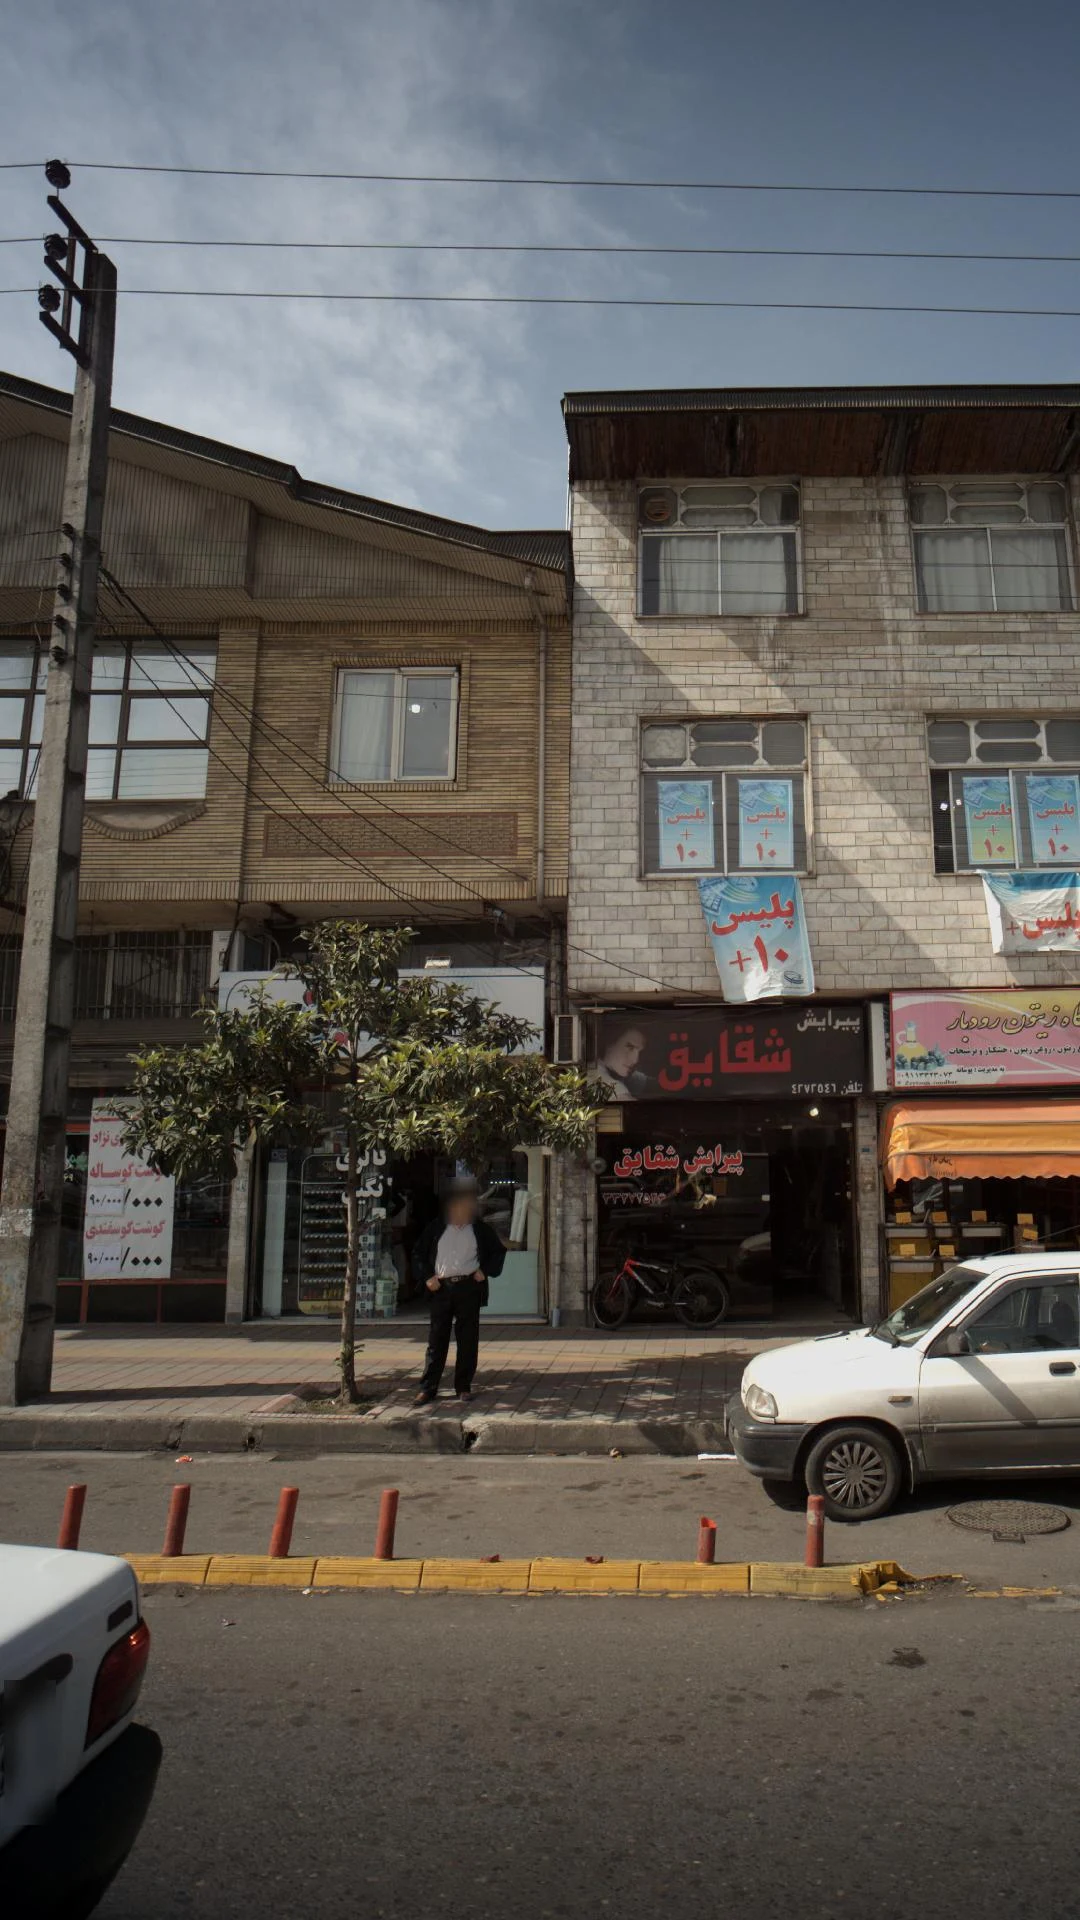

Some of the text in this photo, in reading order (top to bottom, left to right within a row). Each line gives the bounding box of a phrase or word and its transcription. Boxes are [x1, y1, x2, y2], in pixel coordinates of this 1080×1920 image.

[667, 806, 706, 825] پلیس
[746, 805, 787, 824] پلیس
[1036, 801, 1075, 819] پلیس
[676, 843, 698, 863] ۱۰
[755, 842, 777, 862] ۱۰
[984, 838, 1006, 858] ۱۰
[1048, 837, 1069, 857] ۱۰
[711, 892, 795, 936] پلیس
[797, 1008, 860, 1034] پیرایش
[946, 1009, 1001, 1043] رودبار
[1002, 1002, 1061, 1039] زیتون
[657, 1024, 792, 1092] شقایق
[840, 1080, 863, 1096] تلفن
[613, 1143, 744, 1177] پیرایش شقایق
[85, 1220, 166, 1240] گوشت گوسفندی
